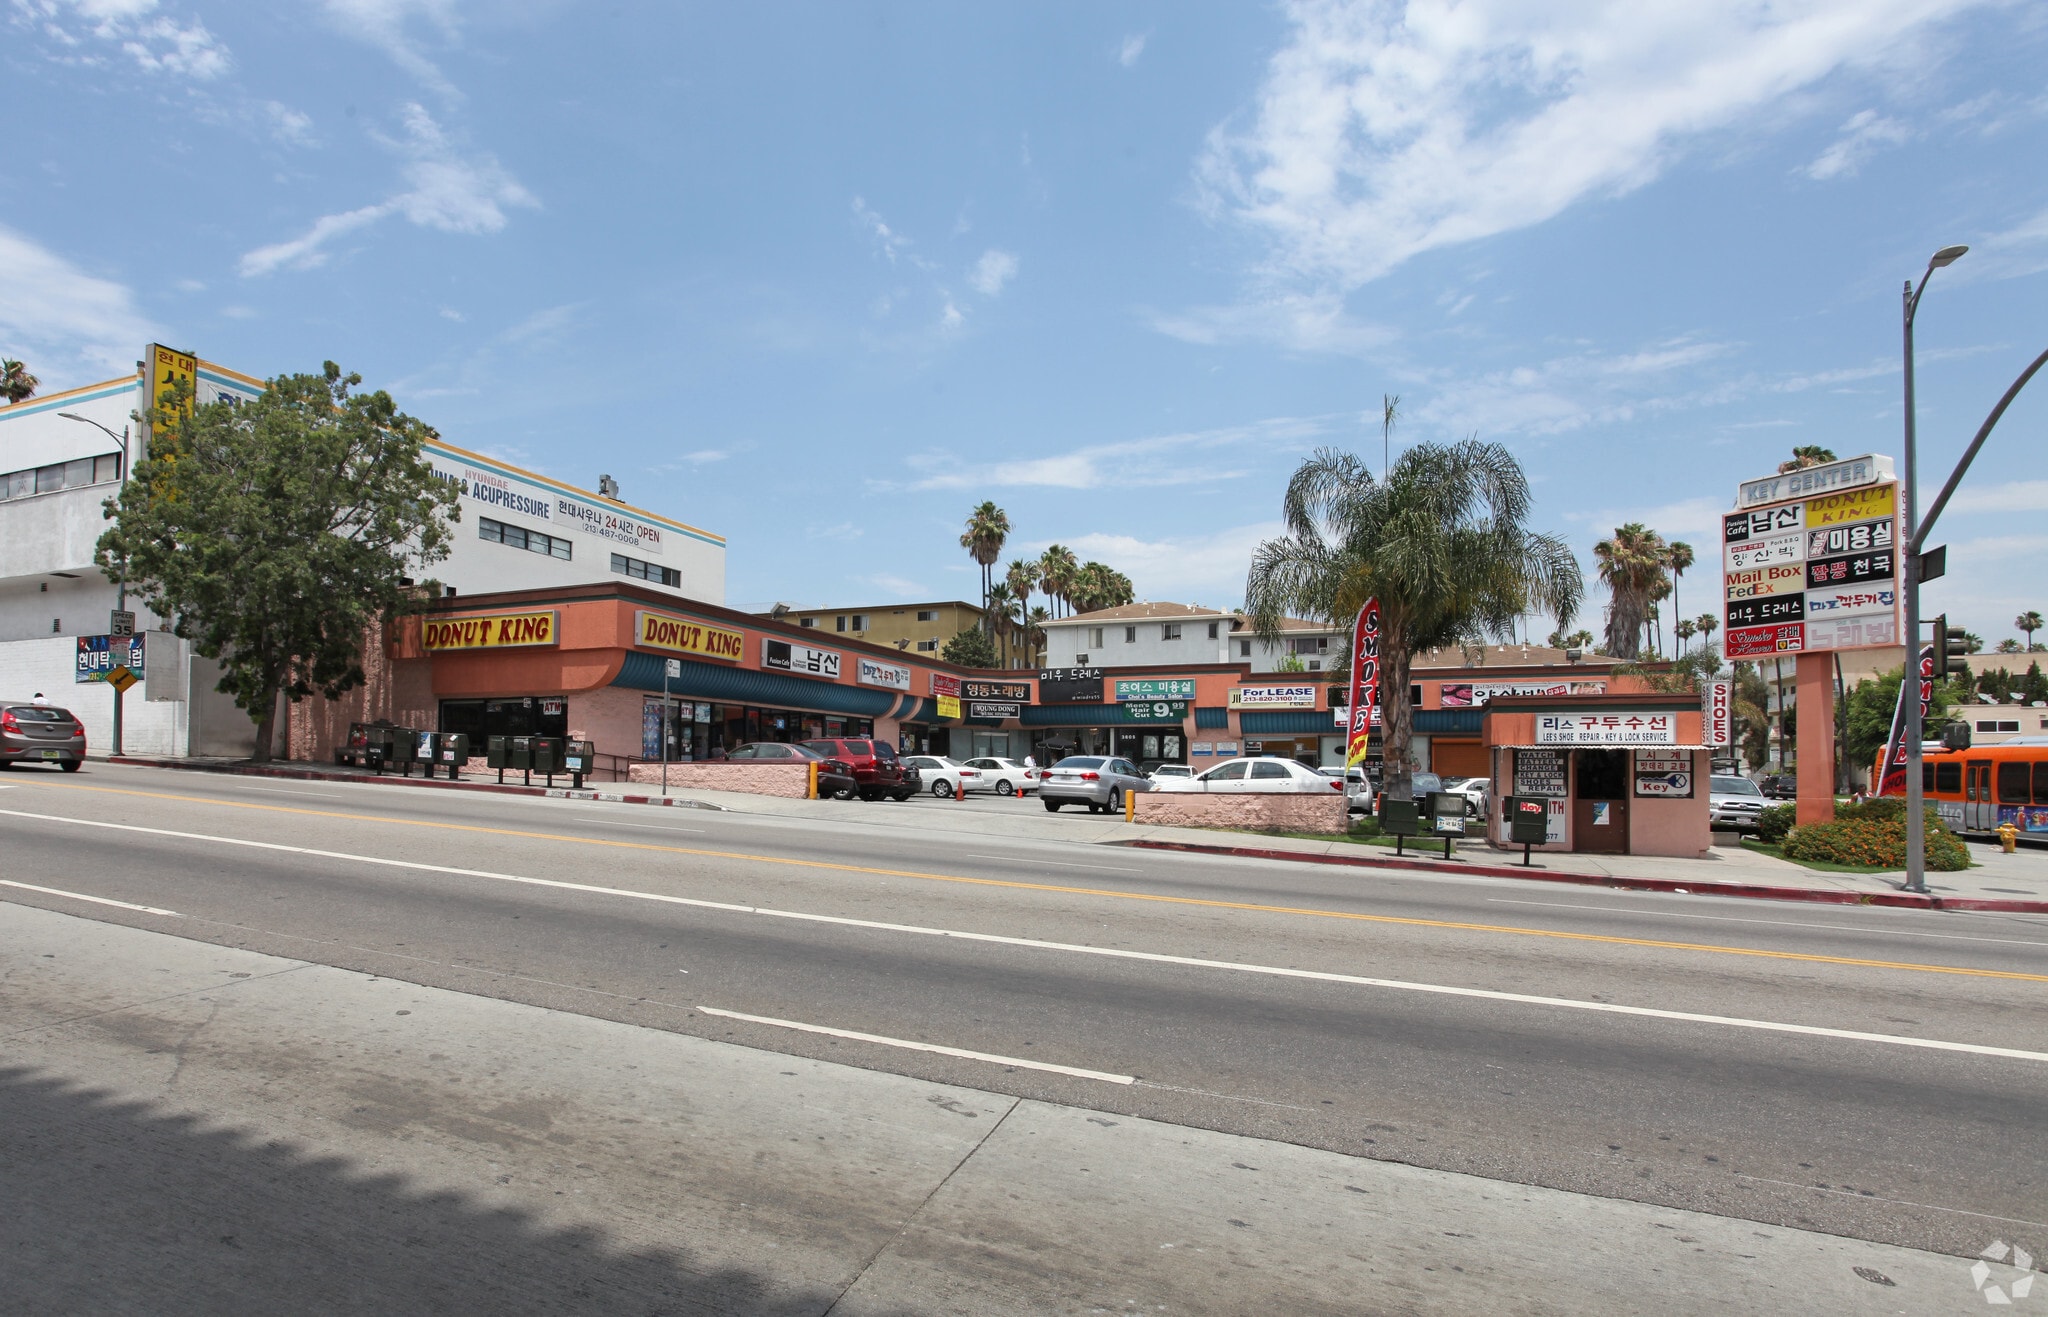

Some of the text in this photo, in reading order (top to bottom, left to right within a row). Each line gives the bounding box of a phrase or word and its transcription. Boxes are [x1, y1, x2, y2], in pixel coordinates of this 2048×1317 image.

[159, 351, 193, 372] 현대
[465, 469, 509, 490] HYUNDAE
[1747, 463, 1866, 501] KEY CENTER
[473, 482, 550, 519] ACUPRESSURE
[1811, 486, 1892, 512] DONUT
[559, 500, 602, 525] 현대사우나
[636, 525, 660, 543] OPEN
[1726, 519, 1747, 528] Fusion
[1751, 506, 1800, 533] 남산
[1727, 525, 1747, 536] Cafe
[1830, 521, 1892, 551] 미용실
[1727, 567, 1801, 585] Mail Box
[1811, 555, 1890, 581] 짬뽕 천국
[1727, 582, 1774, 598] FedEx
[1729, 601, 1802, 622] 미우 드레스
[114, 624, 133, 636] 35
[425, 616, 549, 647] DONUT KING
[645, 618, 741, 657] DONUT KING
[806, 650, 839, 675] 남산
[1041, 669, 1101, 681] 미우 드레스
[967, 683, 1025, 698] 영동노래방
[1119, 681, 1192, 693] 초이스 미용실
[1267, 687, 1313, 696] LEASE
[544, 702, 561, 713] ATM
[1713, 684, 1726, 742] SHOES
[1543, 716, 1667, 730] 리스 구두수선
[1543, 732, 1557, 742] LEE'S
[1558, 732, 1574, 741] SHOE
[1579, 732, 1600, 741] REPAIR
[1605, 732, 1617, 741] KEY
[1618, 733, 1623, 741] &
[1624, 733, 1641, 741] LOCK
[1642, 733, 1667, 742] SERVICE
[1643, 783, 1669, 792] Key
[1520, 802, 1542, 814] Hoy
